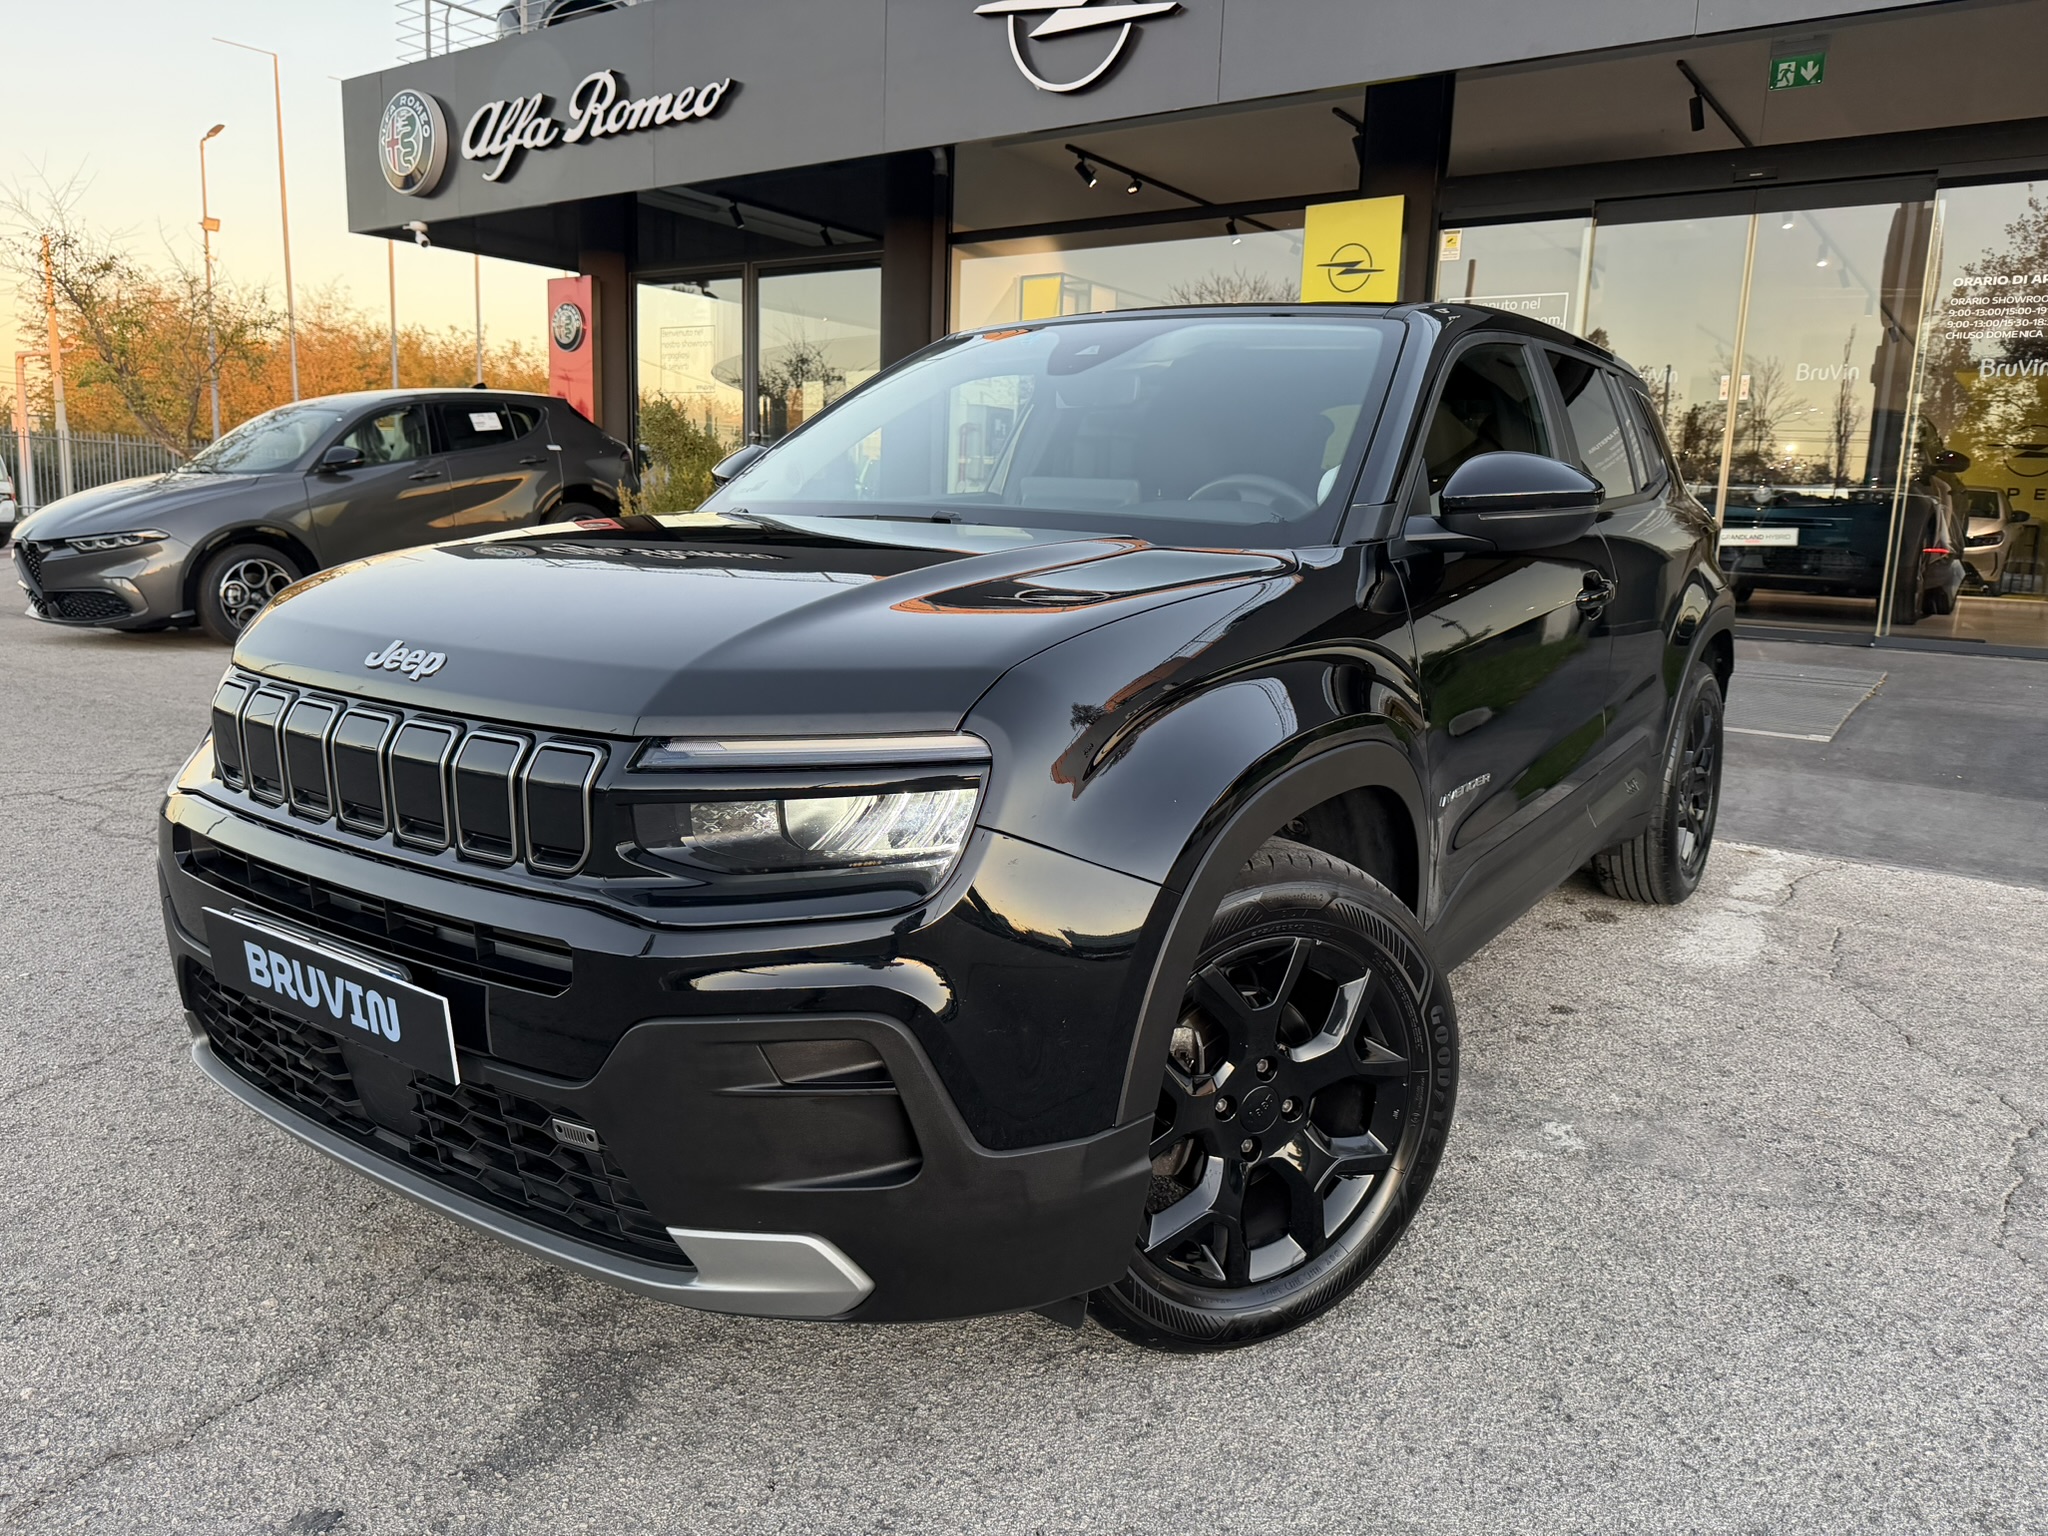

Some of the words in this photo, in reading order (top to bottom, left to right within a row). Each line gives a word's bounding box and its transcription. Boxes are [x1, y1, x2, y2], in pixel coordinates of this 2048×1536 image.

[399, 96, 430, 137] ROMEO
[460, 93, 559, 182] Alfa
[562, 69, 730, 144] Romeo
[1952, 275, 2009, 287] ORARIO
[2012, 274, 2028, 284] DI
[1521, 297, 1541, 310] nel
[1950, 296, 1990, 306] ORARIO
[1945, 331, 1984, 340] CHIUSO
[1986, 330, 2044, 339] DOMENICA
[1795, 362, 1860, 382] BruVin
[2007, 487, 2047, 501] PE
[364, 639, 446, 680] Jeep
[243, 940, 400, 1043] BRUVIN
